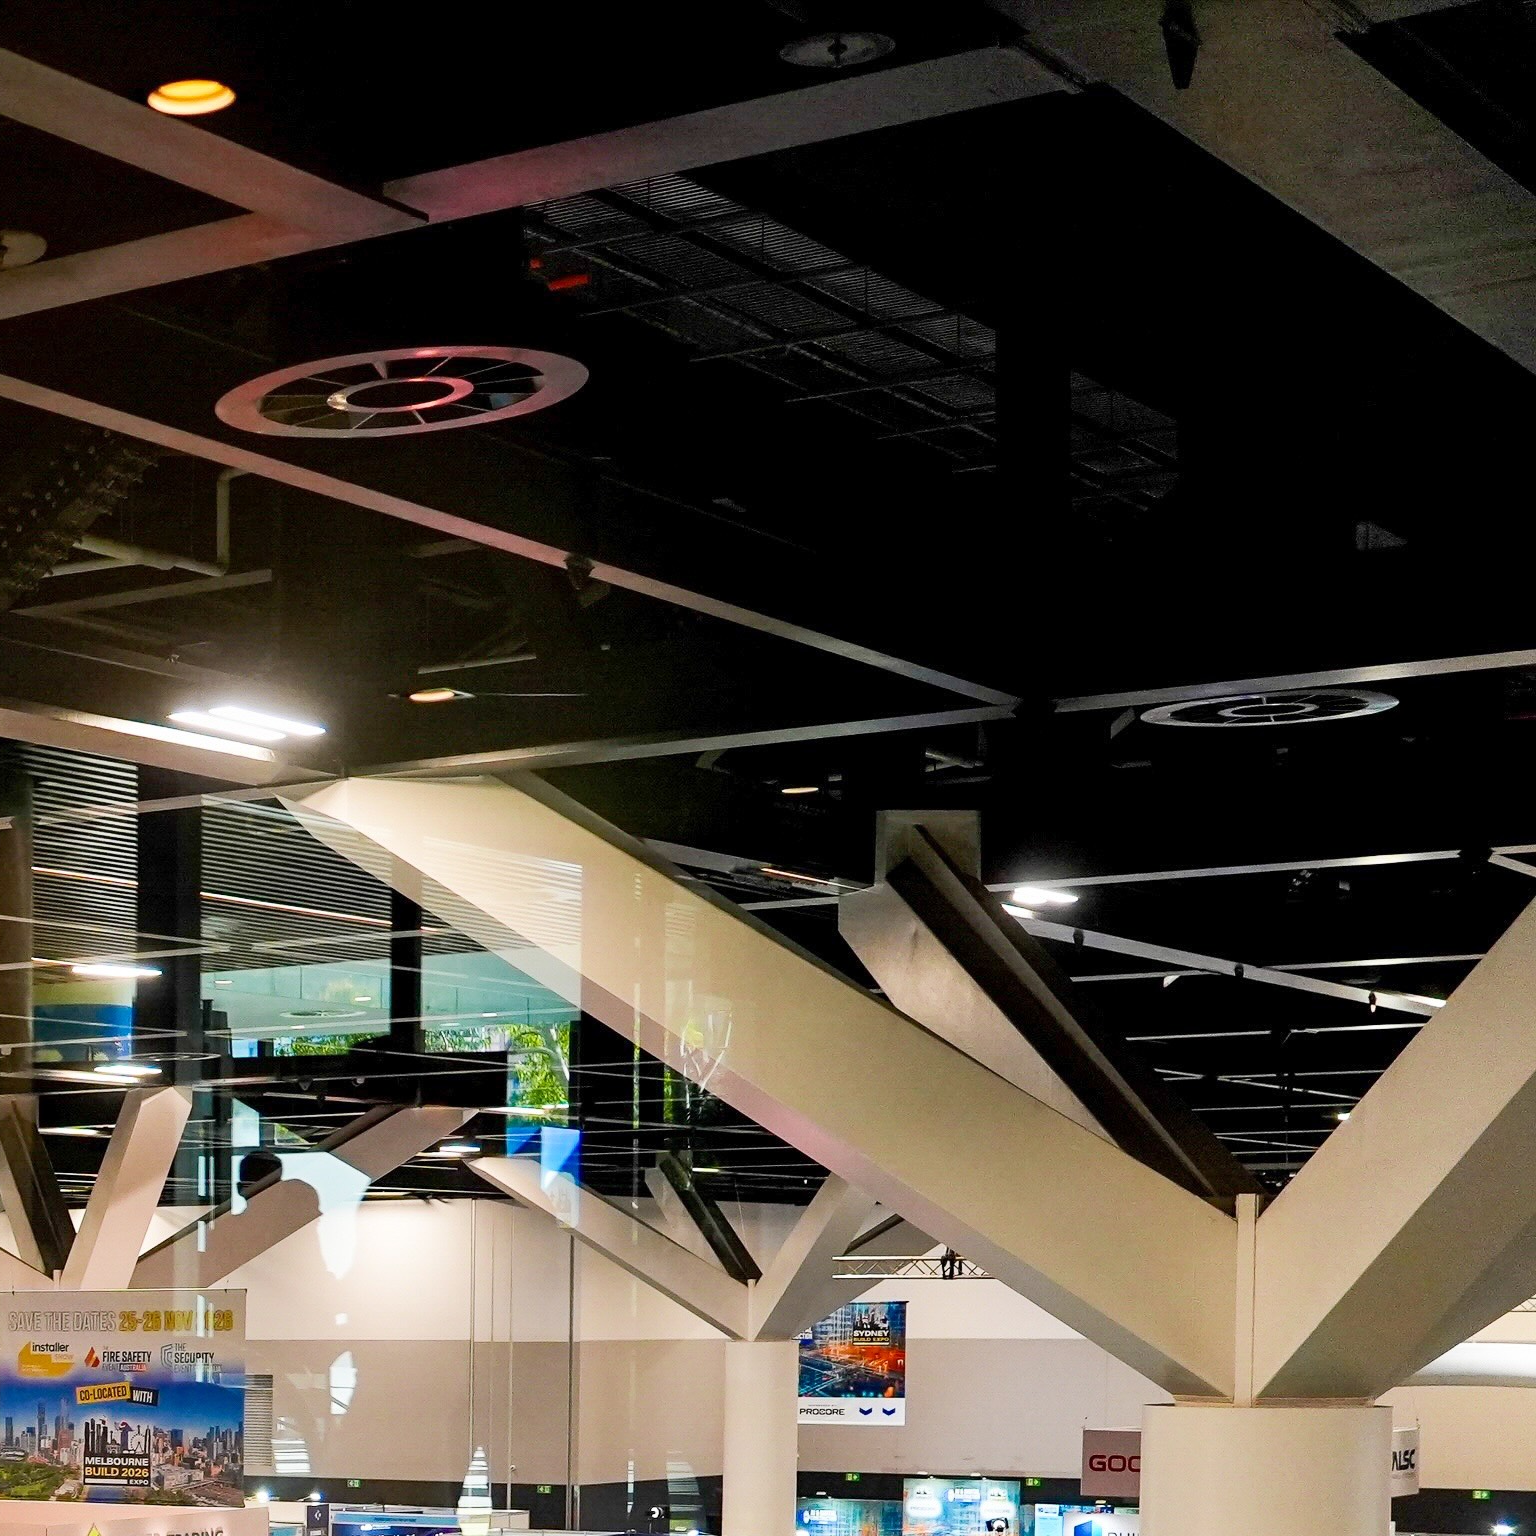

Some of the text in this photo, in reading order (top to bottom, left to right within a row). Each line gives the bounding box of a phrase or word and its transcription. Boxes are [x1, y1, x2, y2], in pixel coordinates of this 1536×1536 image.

[8, 1310, 161, 1332] SAVE THE DATES 25-26
[32, 1342, 69, 1353] installer
[102, 1351, 152, 1363] FIRE SAFETY
[175, 1352, 215, 1364] SECURITY
[79, 1385, 153, 1403] CO-LOCATED WITH
[799, 1408, 845, 1416] PROCORE
[84, 1456, 149, 1467] MELBOURNE
[85, 1467, 149, 1478] BUILD 2026
